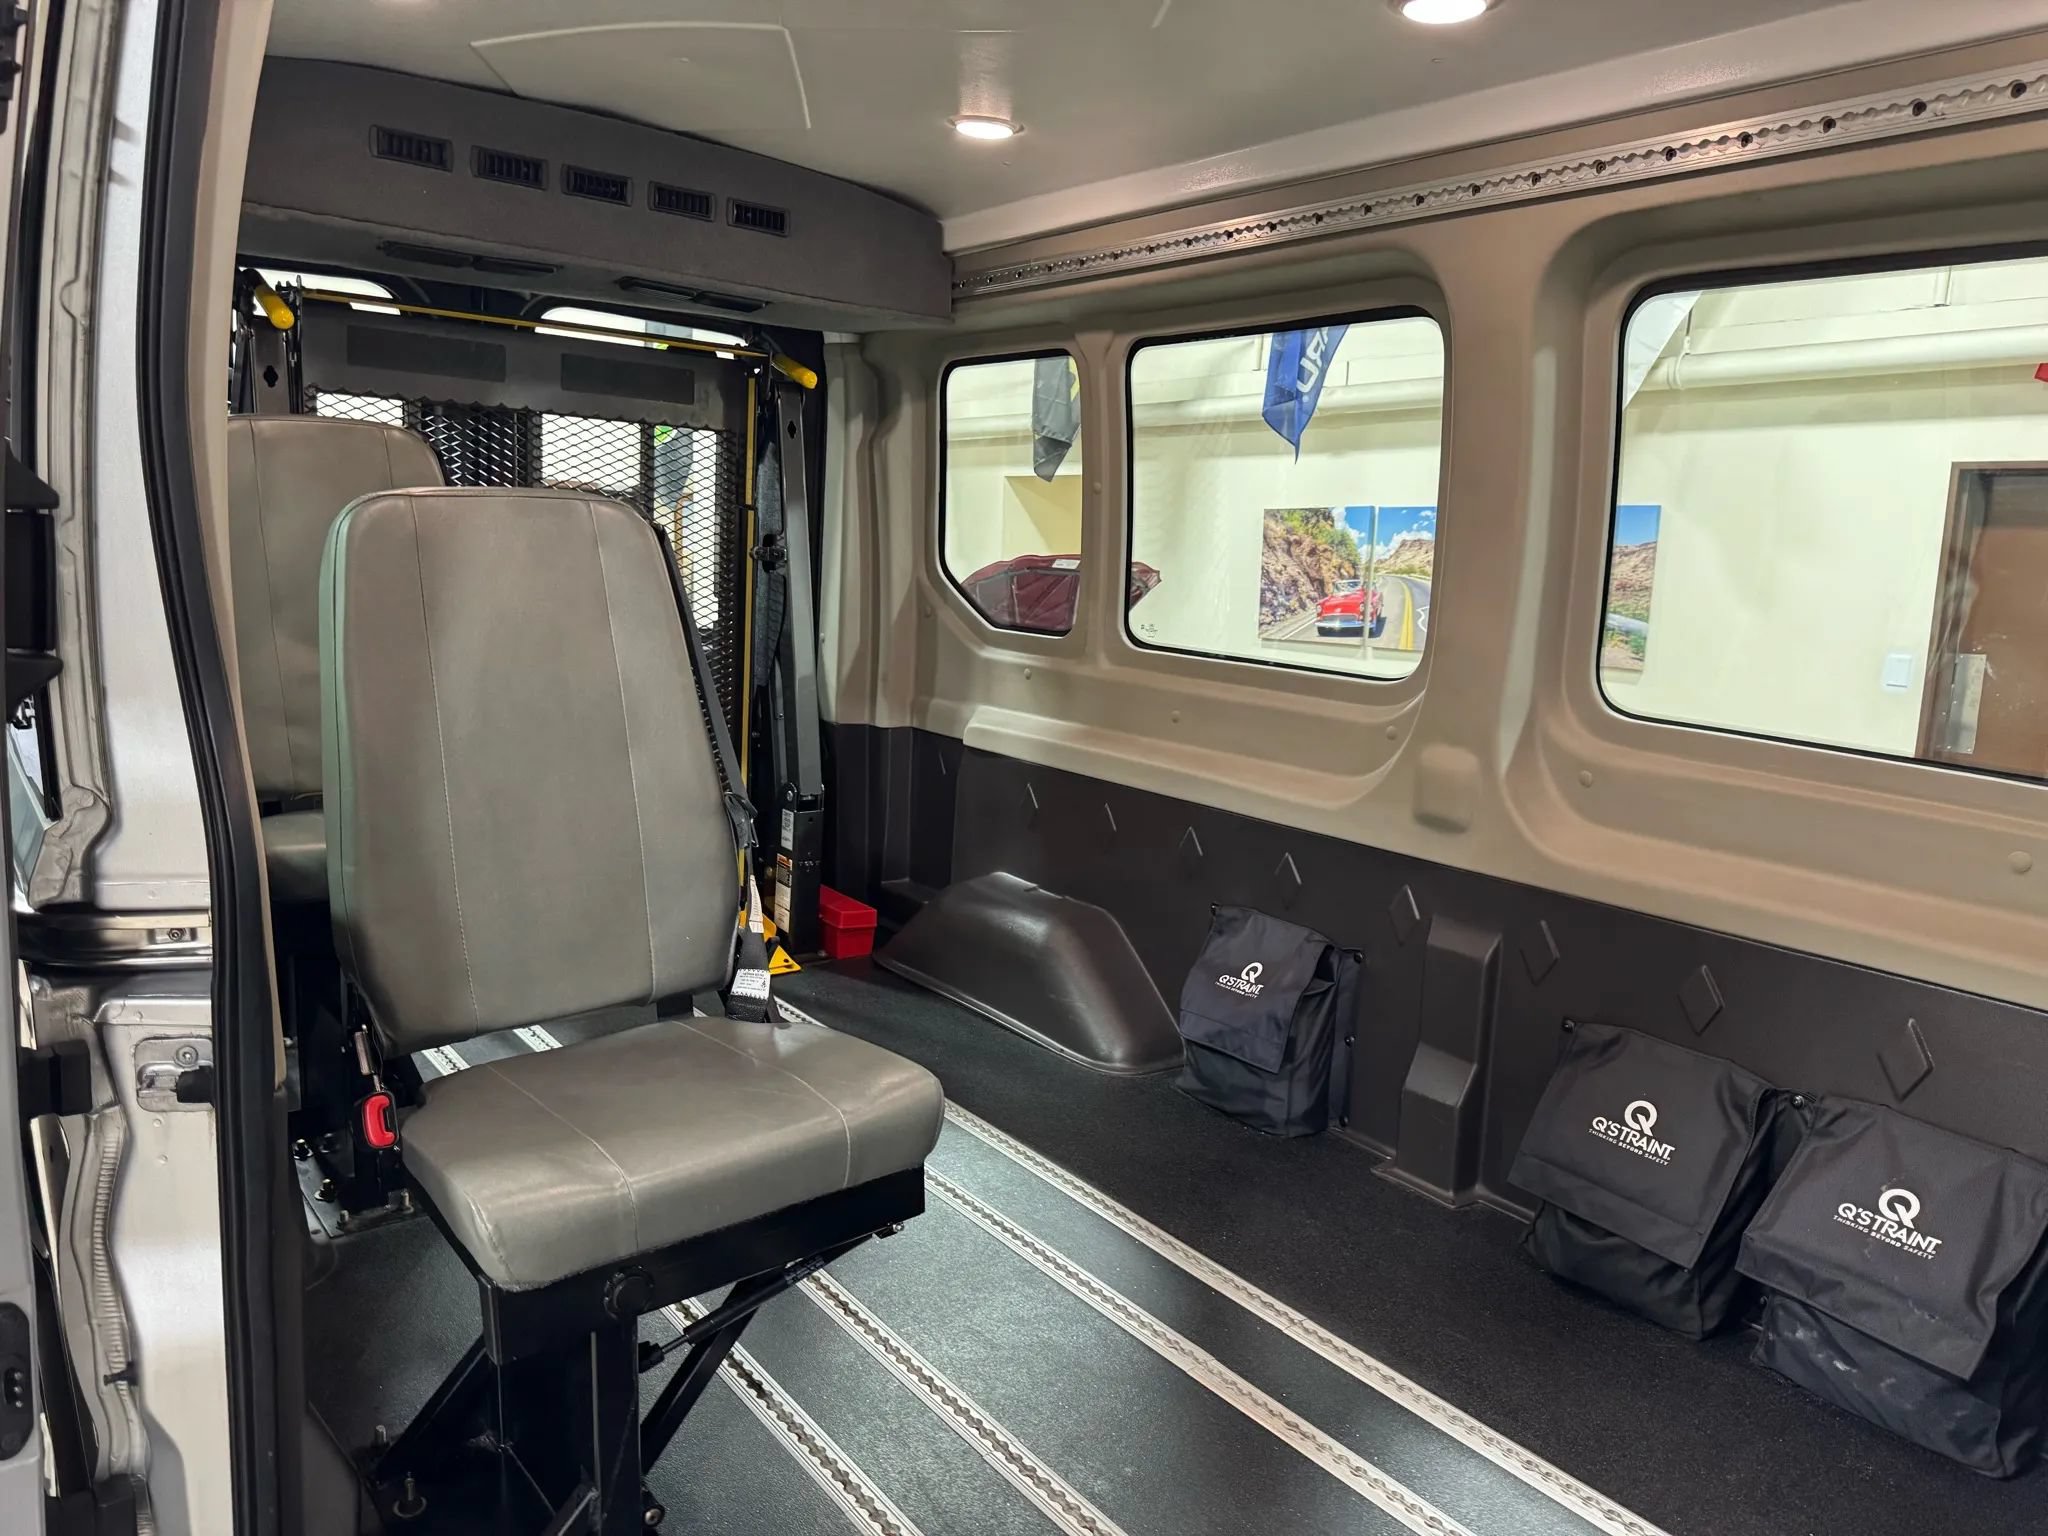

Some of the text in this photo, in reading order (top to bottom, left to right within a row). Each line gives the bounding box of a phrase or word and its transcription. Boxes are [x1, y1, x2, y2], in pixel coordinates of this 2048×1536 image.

[1241, 962, 1263, 983] Q
[1624, 1100, 1657, 1136] Q
[1878, 1189, 1920, 1229] Q
[1833, 1214, 1934, 1260] THINKING BEYOND SAFETY
